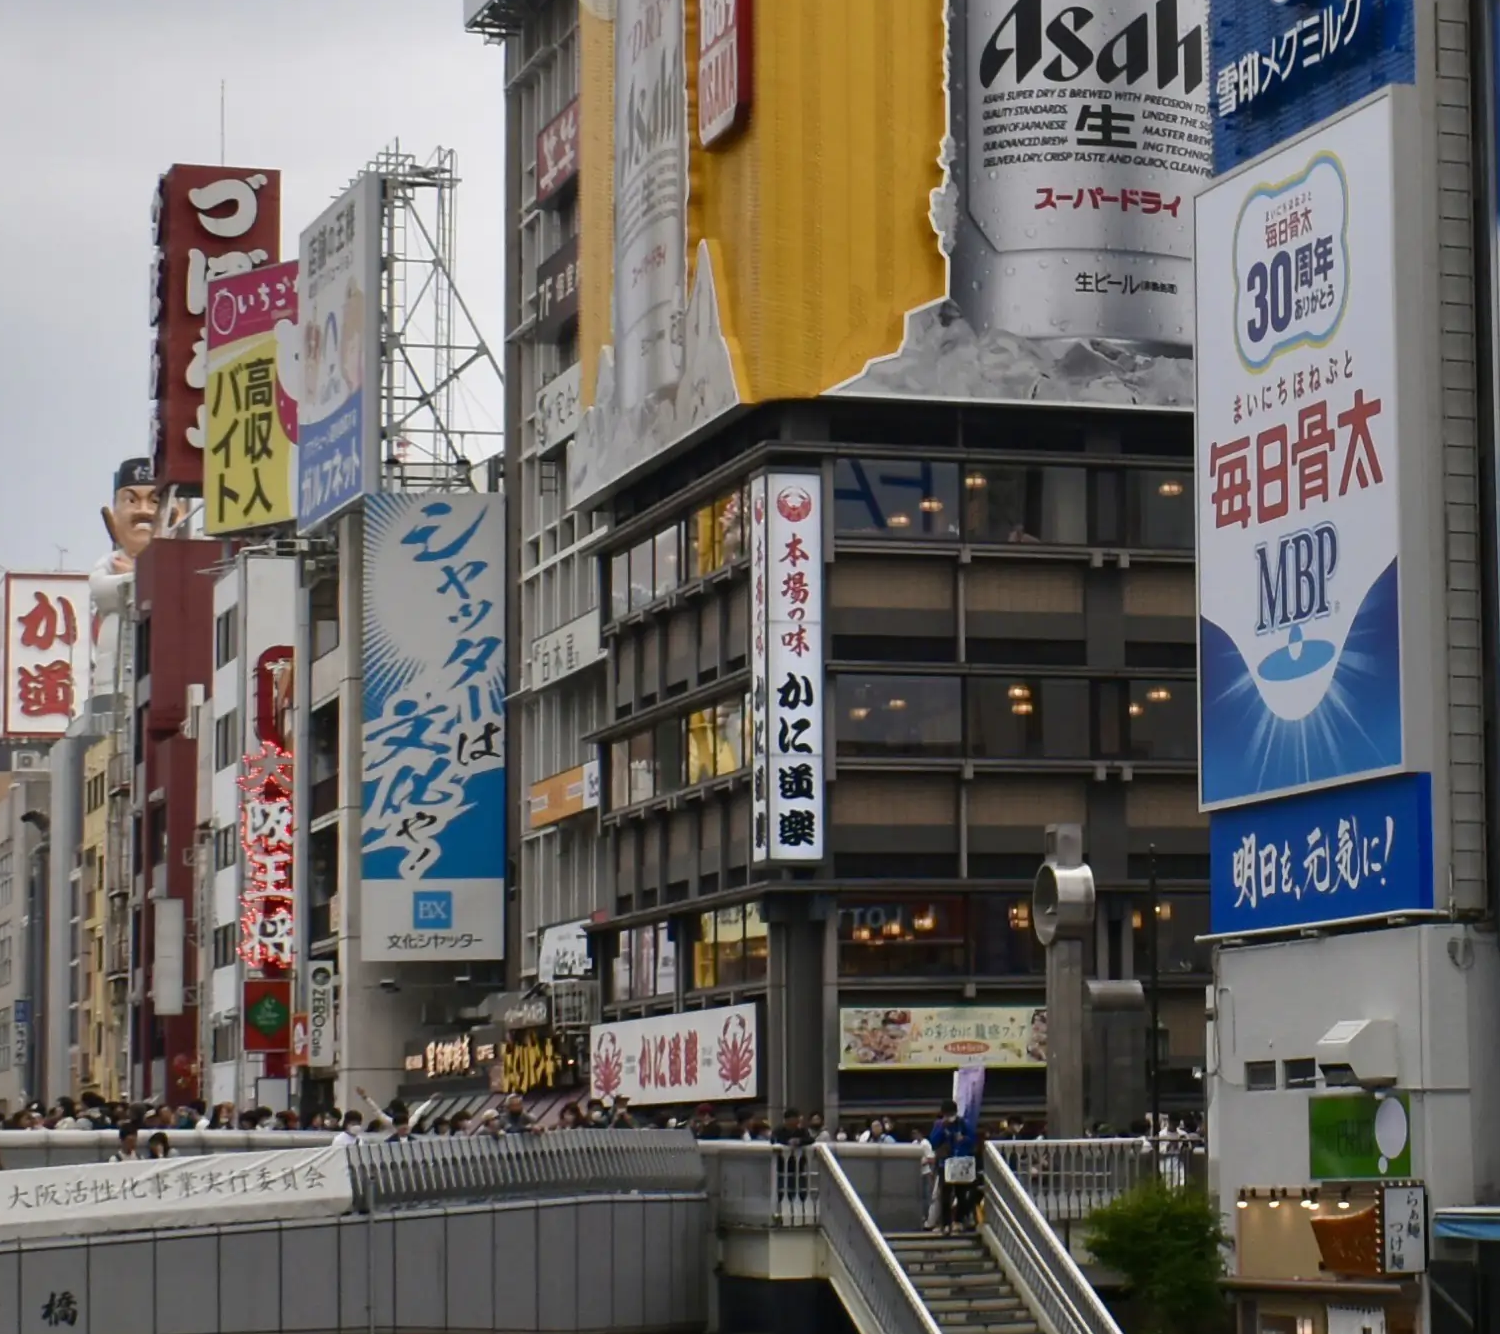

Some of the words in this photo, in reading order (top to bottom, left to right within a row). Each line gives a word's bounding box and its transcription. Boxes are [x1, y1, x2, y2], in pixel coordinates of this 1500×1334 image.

[1007, 90, 1034, 101] SUPER
[1035, 89, 1056, 101] DRY
[1069, 89, 1112, 102] BREWED
[1114, 91, 1142, 104] WITH
[1144, 94, 1194, 112] PRECISION
[1076, 105, 1138, 149] 生
[1142, 110, 1174, 124] UNDER
[1175, 115, 1198, 127] THE
[1142, 126, 1177, 141] MASTER
[1043, 153, 1072, 164] CRISP
[1073, 153, 1106, 164] TASTE
[1107, 153, 1132, 165] AND
[1170, 159, 1199, 175] CLEAN
[1034, 186, 1182, 219] スーパードライ
[1265, 207, 1313, 249] 毎日骨太
[1247, 234, 1335, 344] 30周年
[1294, 283, 1335, 322] ありがとう
[1231, 348, 1354, 424] まいにちほねぶと
[211, 361, 243, 524] バイト
[243, 357, 274, 517] 高収入
[1209, 388, 1384, 530] 毎日骨太
[779, 533, 811, 658] 本場の味
[1253, 520, 1340, 635] MBP
[17, 590, 78, 651] か
[18, 659, 77, 717] 道
[776, 671, 815, 848] かに道楽
[236, 731, 294, 969] 大阪王将
[418, 900, 446, 919] BX
[387, 933, 484, 950] 文化シャッター
[638, 1029, 700, 1089] かに道楽
[7, 1167, 326, 1211] 大阪活性化事業実行委員会
